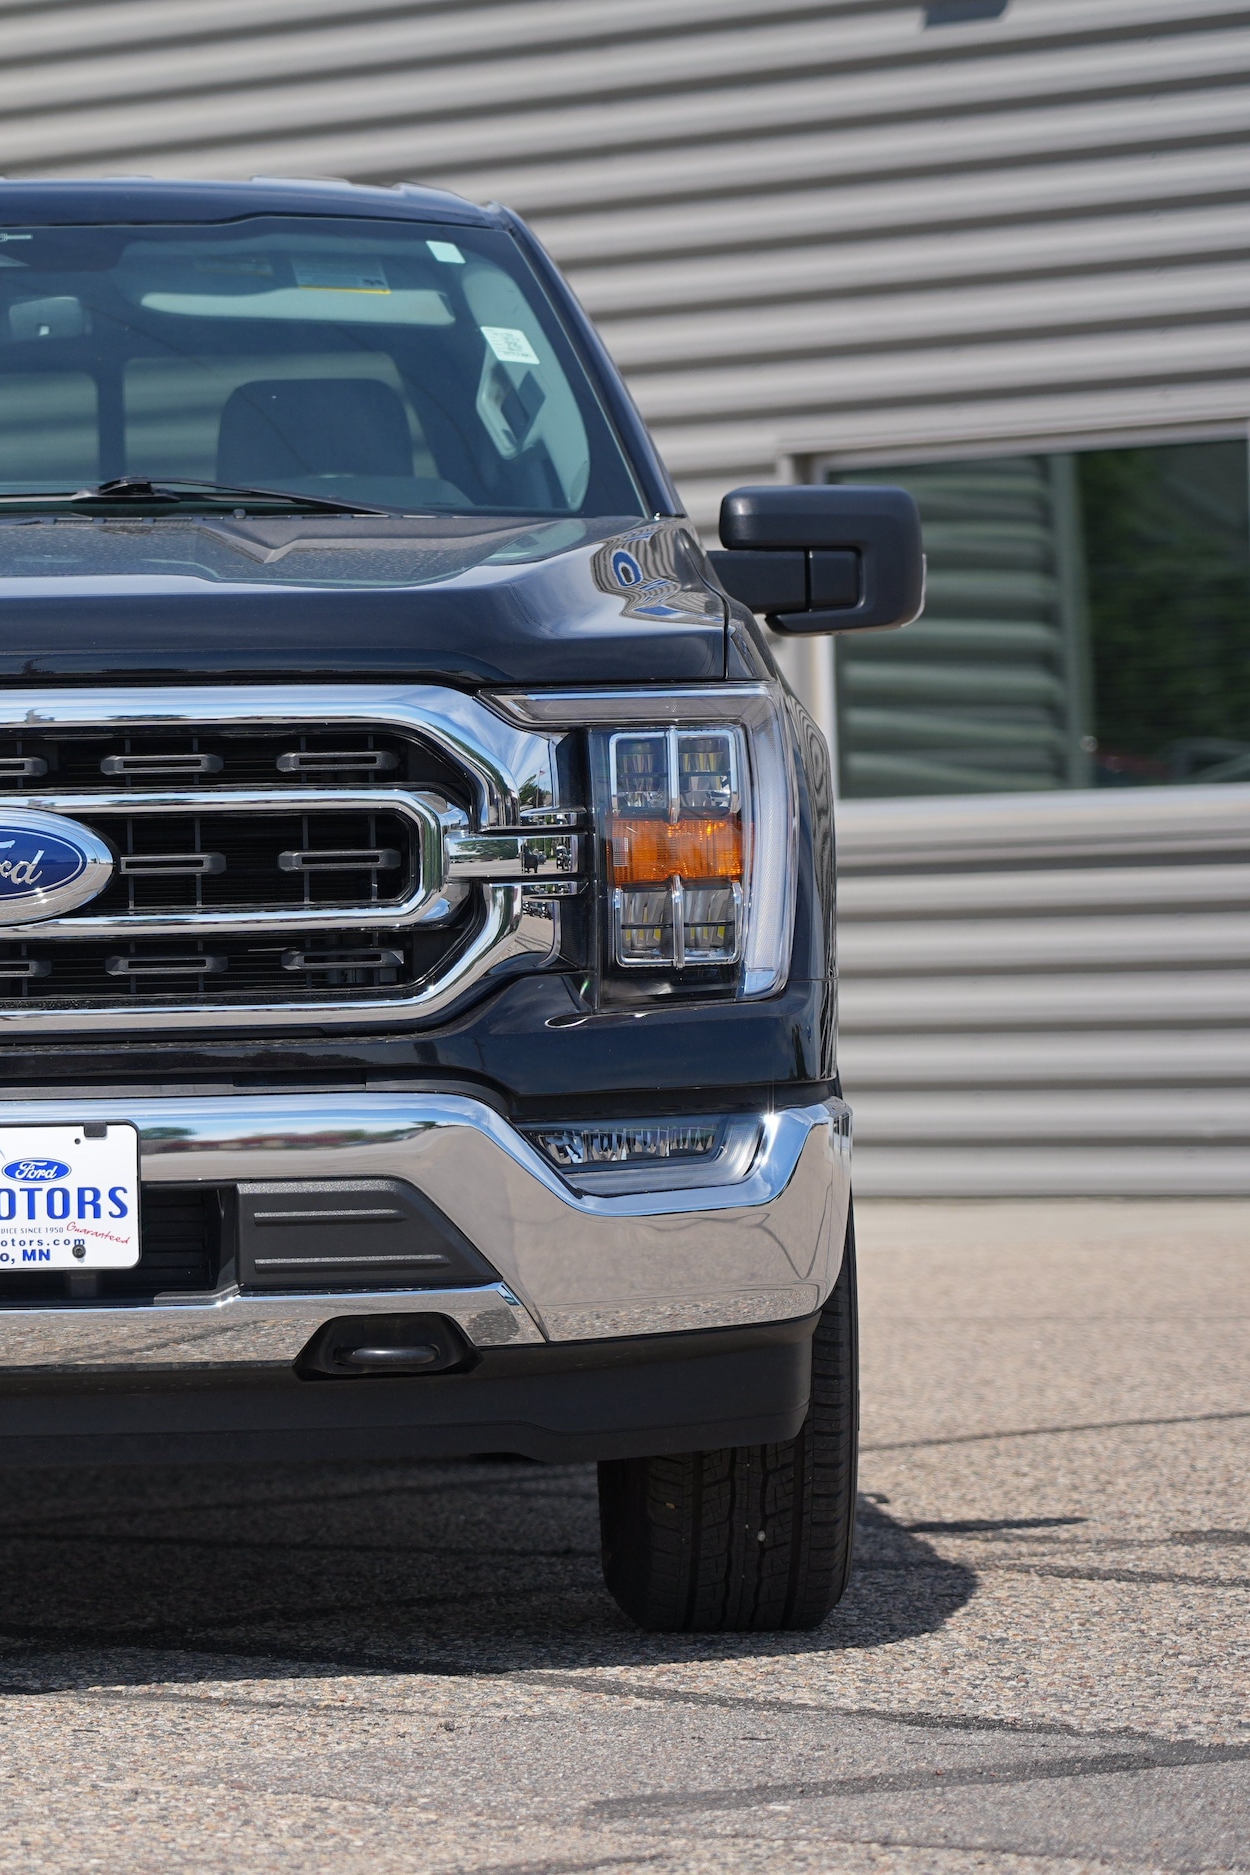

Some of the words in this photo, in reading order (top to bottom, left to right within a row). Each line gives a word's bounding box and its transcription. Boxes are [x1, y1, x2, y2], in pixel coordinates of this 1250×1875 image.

[15, 1161, 59, 1179] Ford
[45, 1226, 64, 1234] 1950
[66, 1221, 131, 1245] Guaranteed
[22, 1249, 51, 1262] MN
